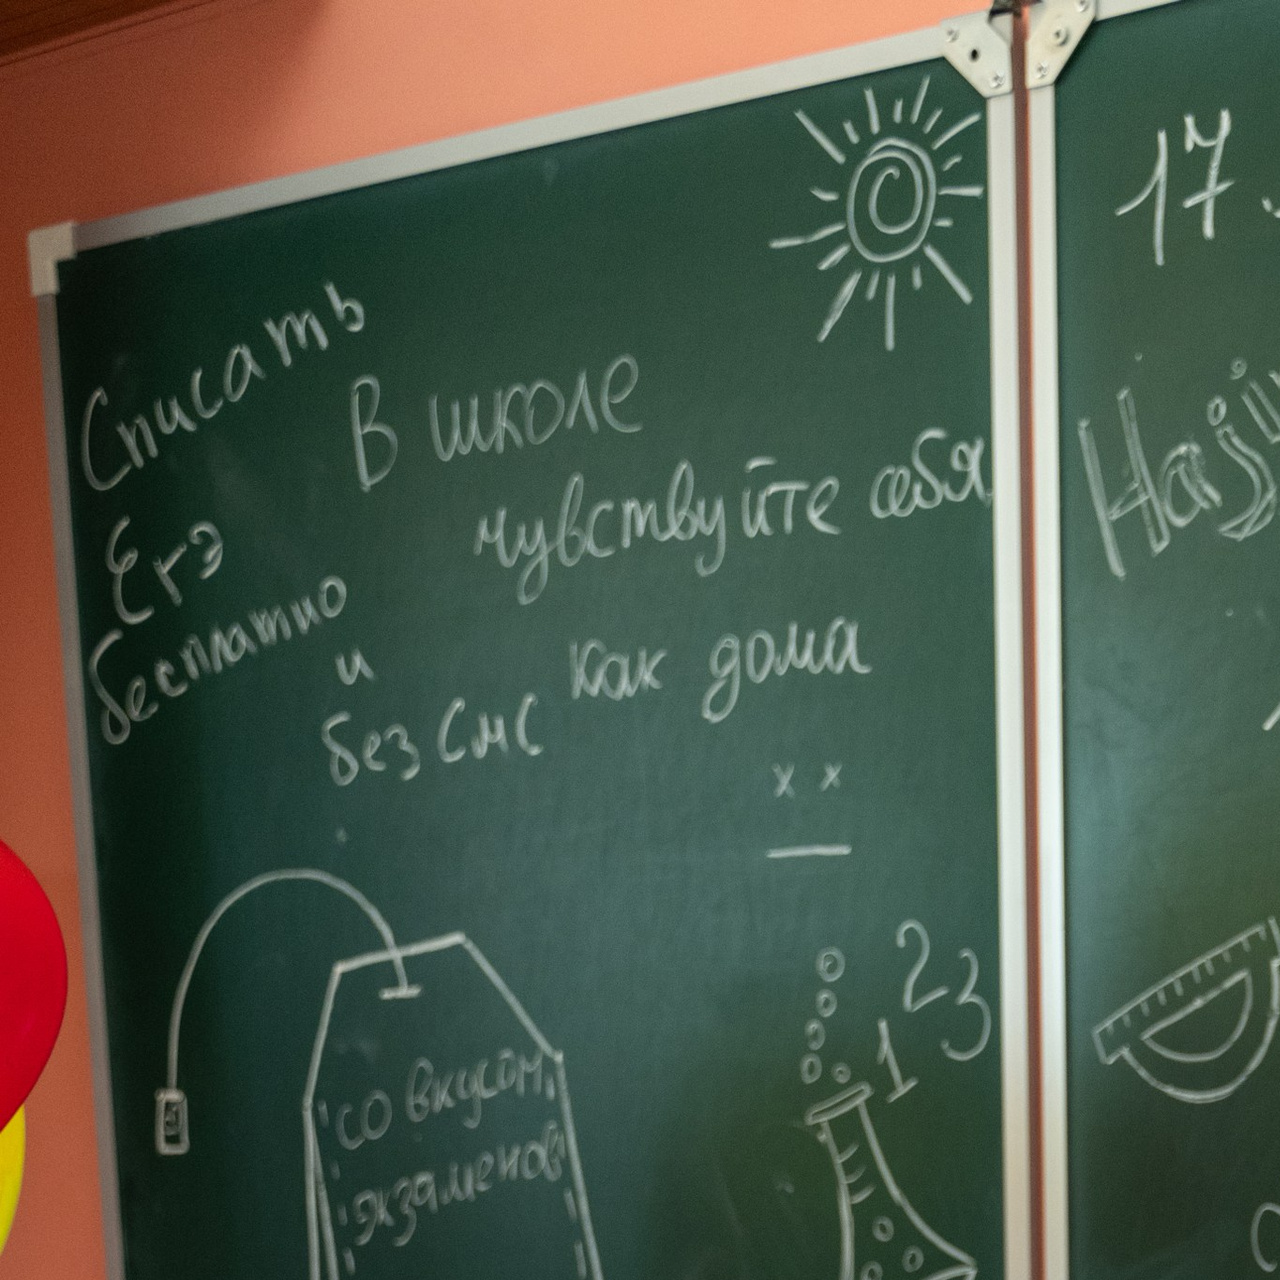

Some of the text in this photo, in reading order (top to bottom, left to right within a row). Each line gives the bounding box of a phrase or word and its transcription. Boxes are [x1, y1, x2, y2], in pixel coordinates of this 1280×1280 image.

[1115, 108, 1236, 266] 17
[80, 280, 367, 492] Списать
[427, 354, 643, 462] школе
[868, 427, 994, 520] себя
[88, 574, 347, 745] бесплатно
[702, 615, 874, 724] дома
[320, 711, 422, 786] без
